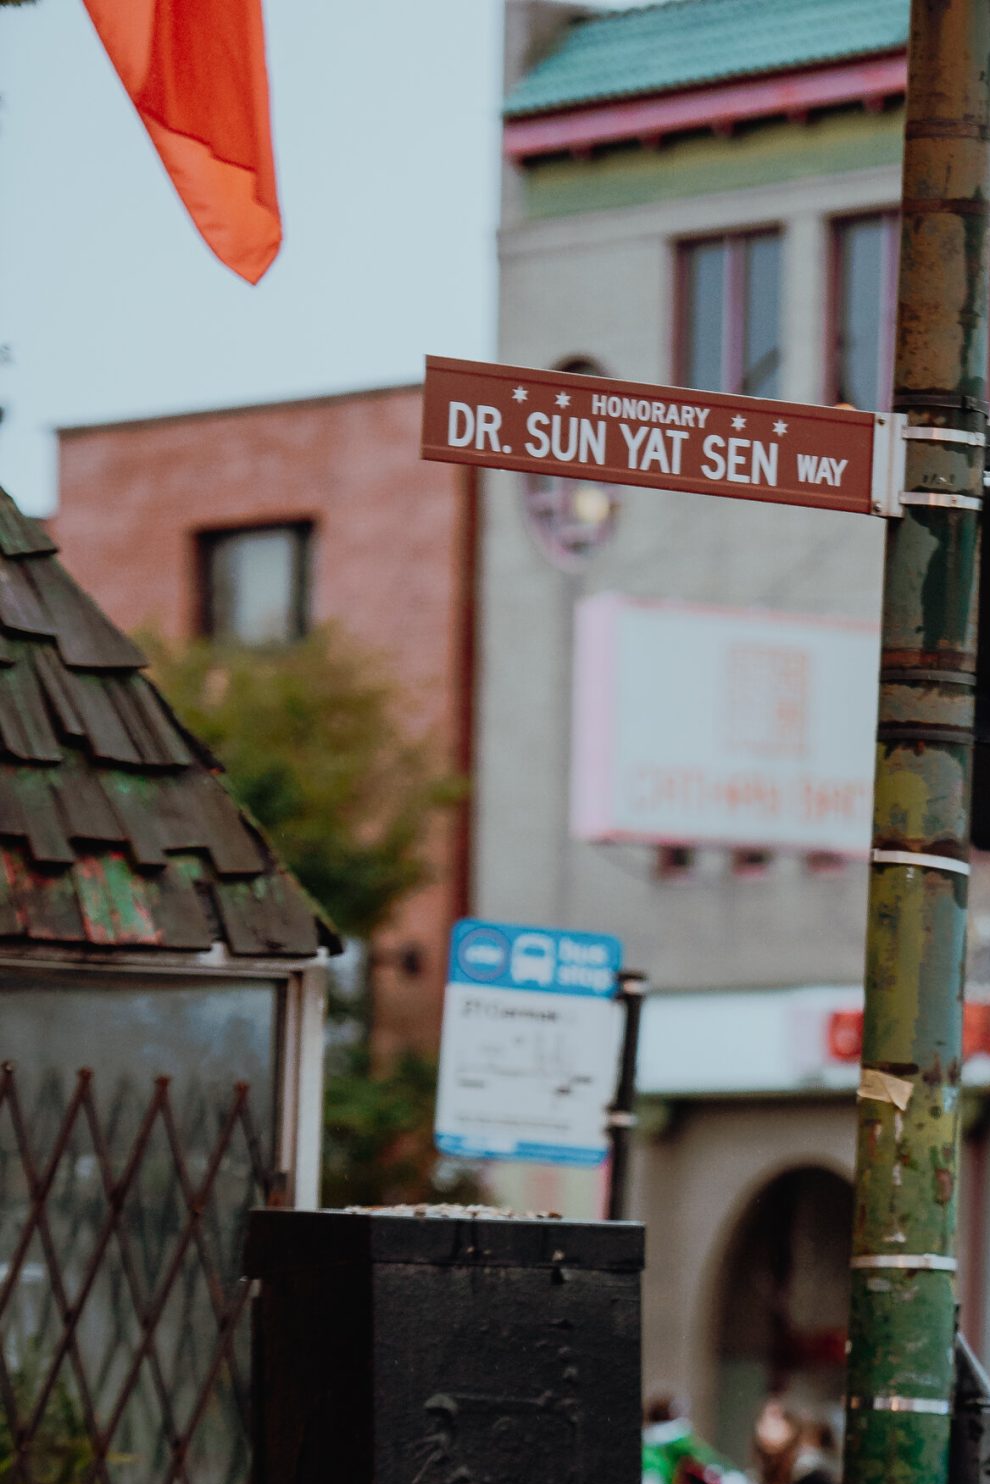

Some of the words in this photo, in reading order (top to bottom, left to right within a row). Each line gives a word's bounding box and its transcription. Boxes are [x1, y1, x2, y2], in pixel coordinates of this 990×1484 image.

[591, 394, 710, 429] HONORARY
[447, 401, 513, 454] DR.
[524, 412, 606, 465] SUN
[619, 423, 690, 475] YAT
[701, 434, 778, 486] SEN
[796, 453, 849, 487] WAY
